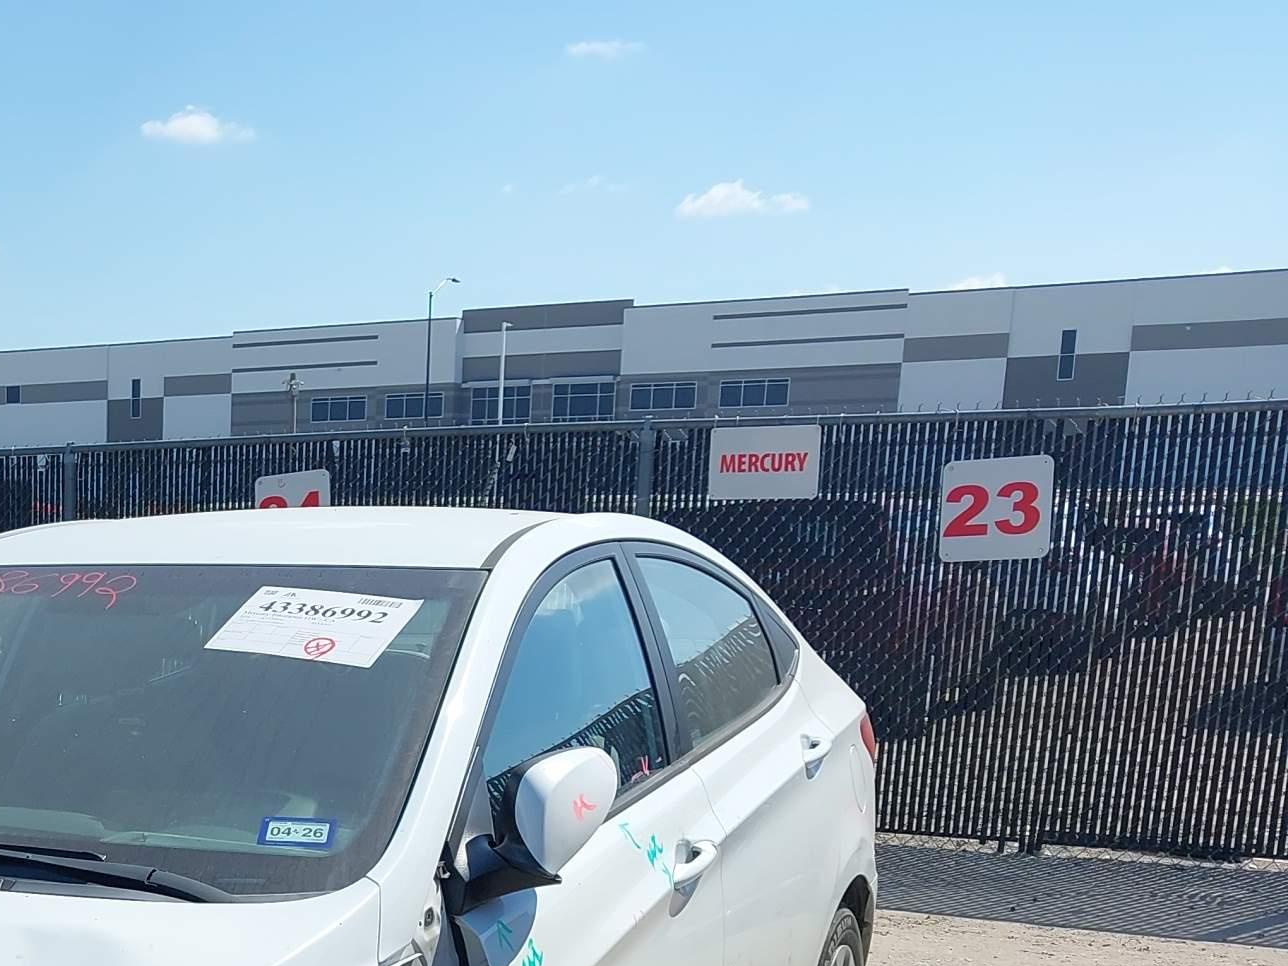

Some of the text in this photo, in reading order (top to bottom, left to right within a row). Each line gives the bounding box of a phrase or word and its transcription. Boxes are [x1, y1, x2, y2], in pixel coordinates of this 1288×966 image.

[719, 452, 809, 474] MERCURY
[942, 481, 1041, 538] 23
[258, 600, 389, 624] 43386992
